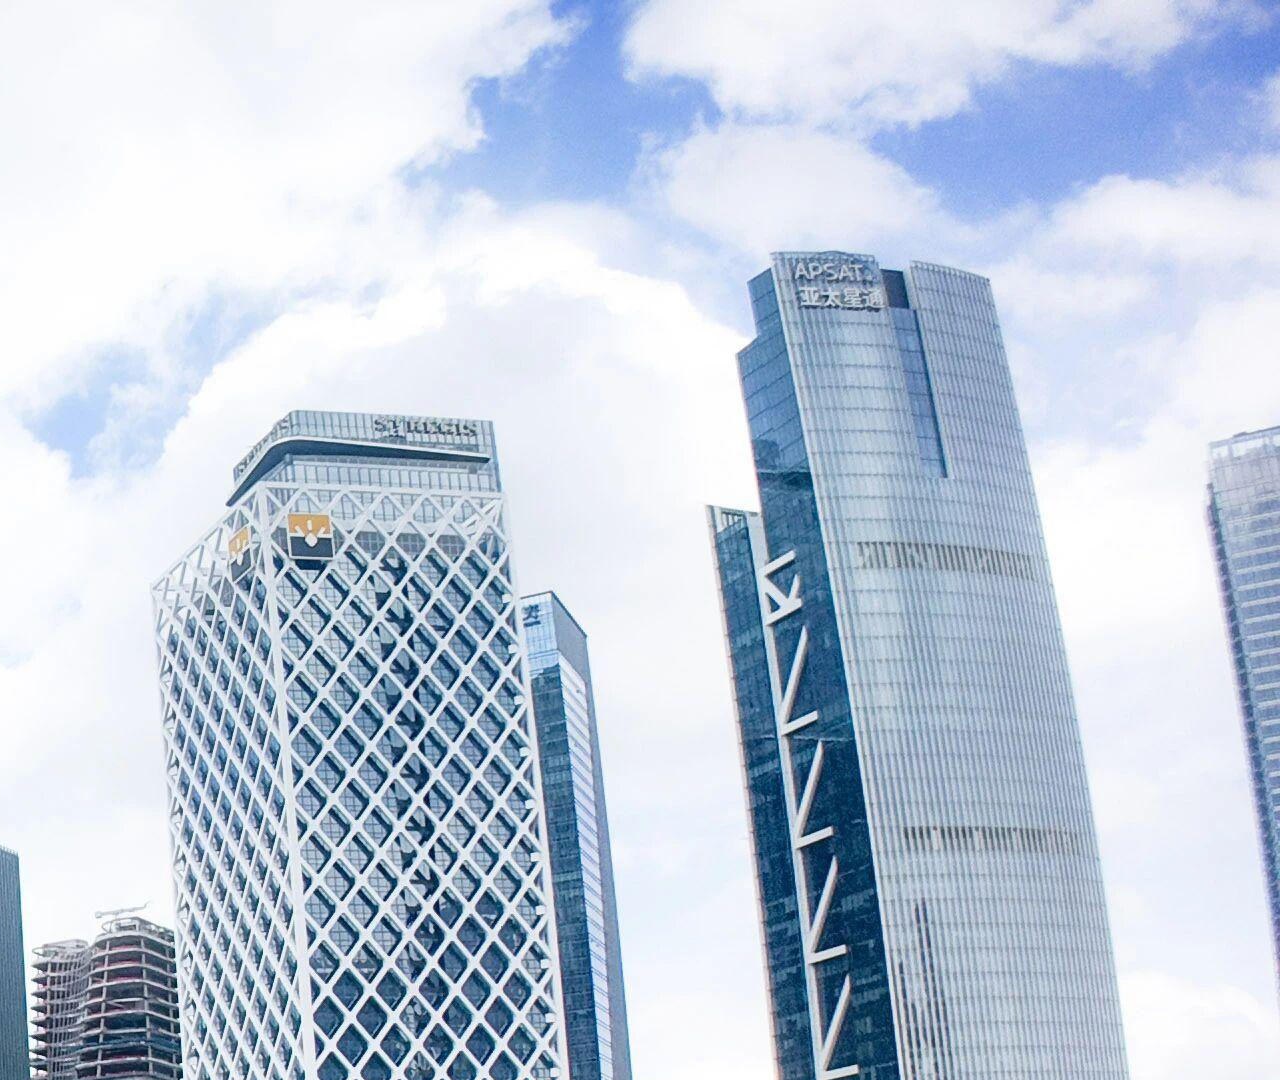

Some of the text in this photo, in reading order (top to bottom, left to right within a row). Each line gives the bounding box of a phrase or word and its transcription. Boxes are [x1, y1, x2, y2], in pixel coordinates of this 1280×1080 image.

[794, 262, 863, 281] APSAT
[798, 286, 888, 309] 亚太星通
